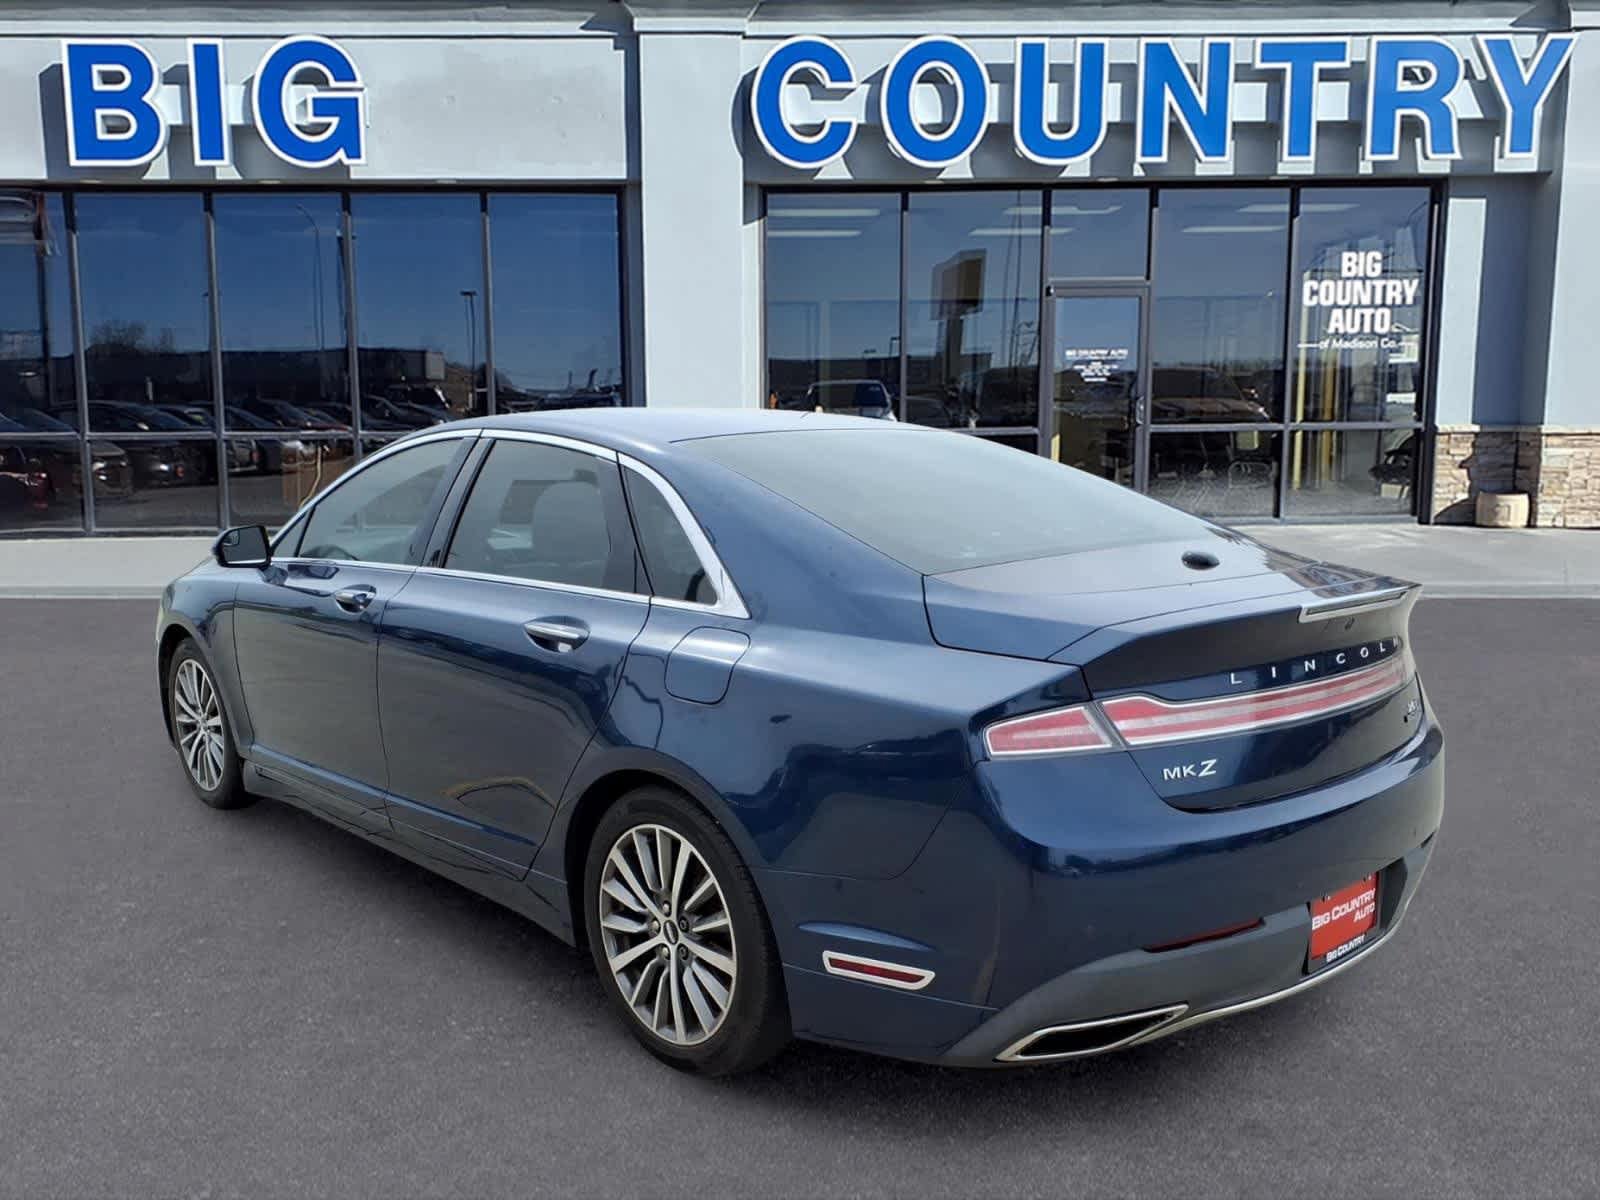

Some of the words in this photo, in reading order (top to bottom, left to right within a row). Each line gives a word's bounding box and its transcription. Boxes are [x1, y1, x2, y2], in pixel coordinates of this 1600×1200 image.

[62, 35, 367, 169] BIG
[751, 33, 1579, 170] COUNTRY
[1341, 251, 1383, 278] BIG
[1303, 278, 1419, 306] COUNTRY
[1327, 308, 1391, 334] AUTO
[1331, 338, 1378, 349] Madison
[1163, 759, 1217, 780] MKZ
[1312, 911, 1331, 930] BIG
[1331, 888, 1375, 921] COUNTRY
[1353, 902, 1375, 923] AUTO
[1326, 951, 1338, 963] BIG
[1337, 935, 1365, 957] COUNTRY
